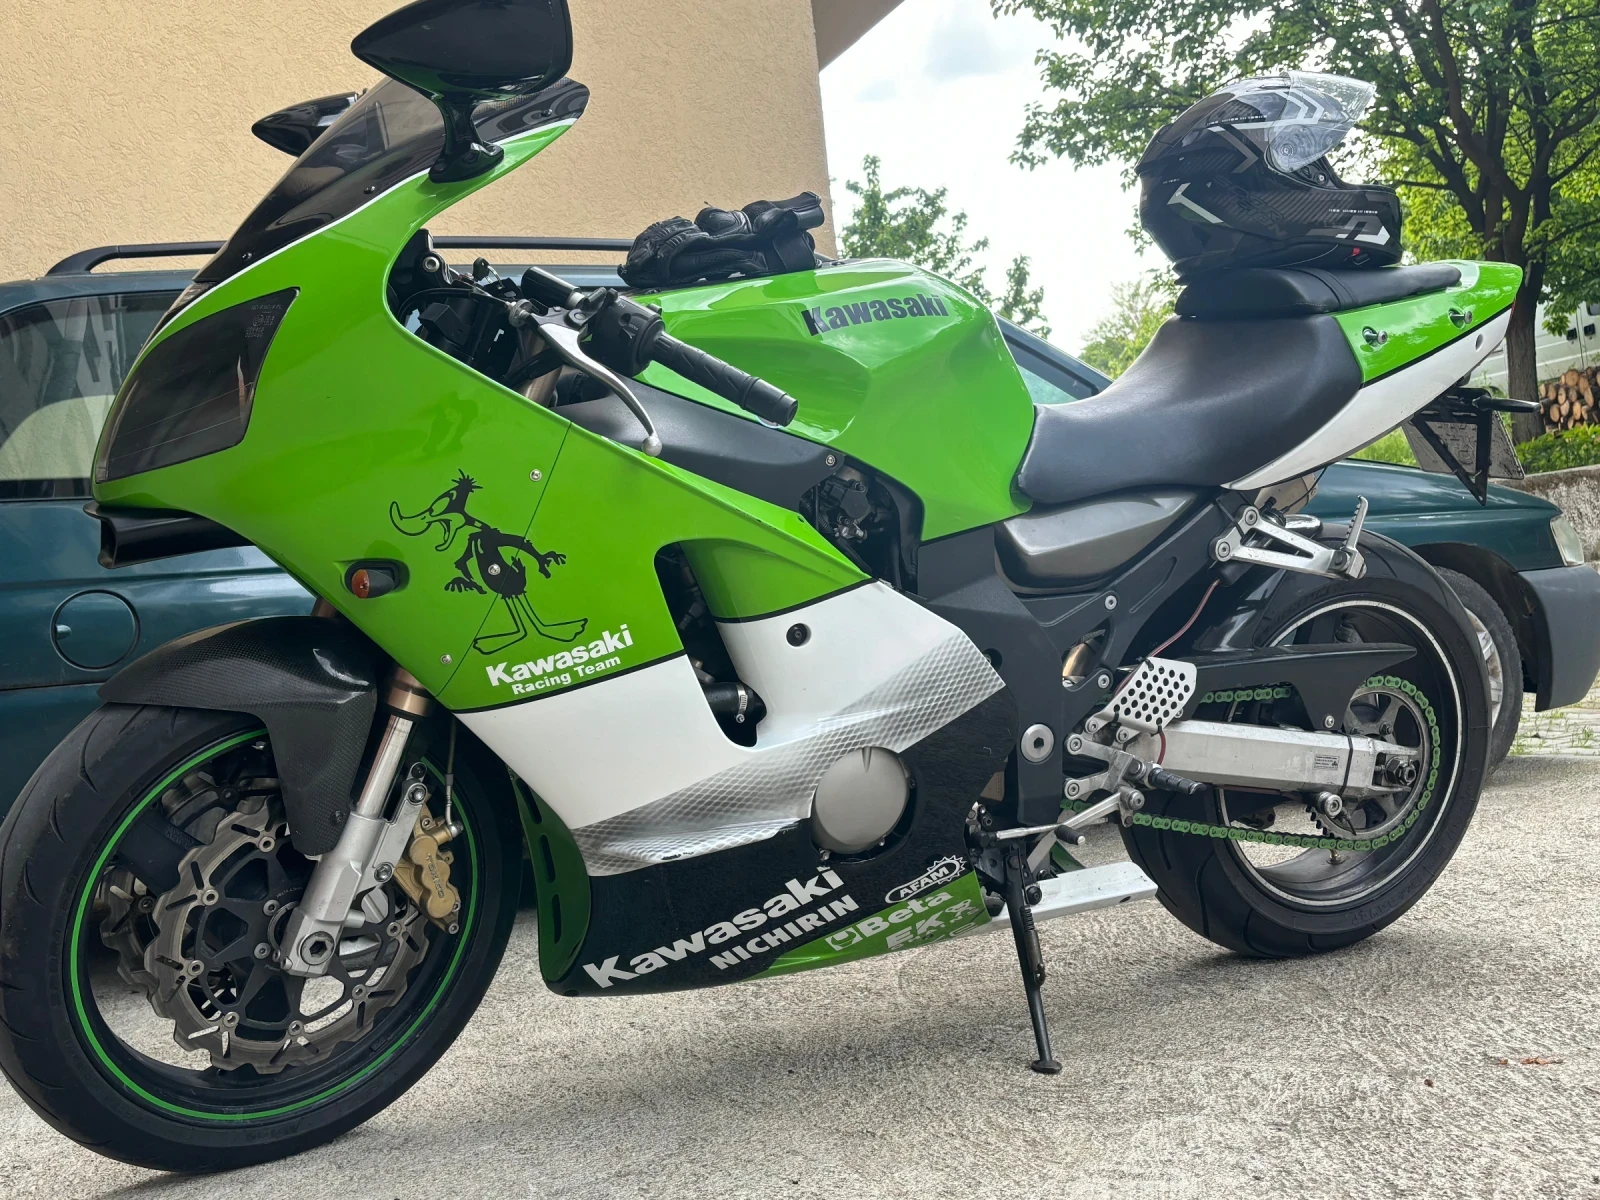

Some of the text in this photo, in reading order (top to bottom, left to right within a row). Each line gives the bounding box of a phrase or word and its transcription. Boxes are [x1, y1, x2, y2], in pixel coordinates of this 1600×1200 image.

[801, 293, 950, 337] Kawasaki
[485, 623, 634, 687] Kawasaki
[511, 656, 621, 695] Racing Team
[899, 866, 950, 899] AFAM
[582, 866, 845, 989] Kawasaki
[709, 894, 860, 971] NICHIRIN
[856, 891, 954, 938] Beta
[885, 910, 947, 950] EK
